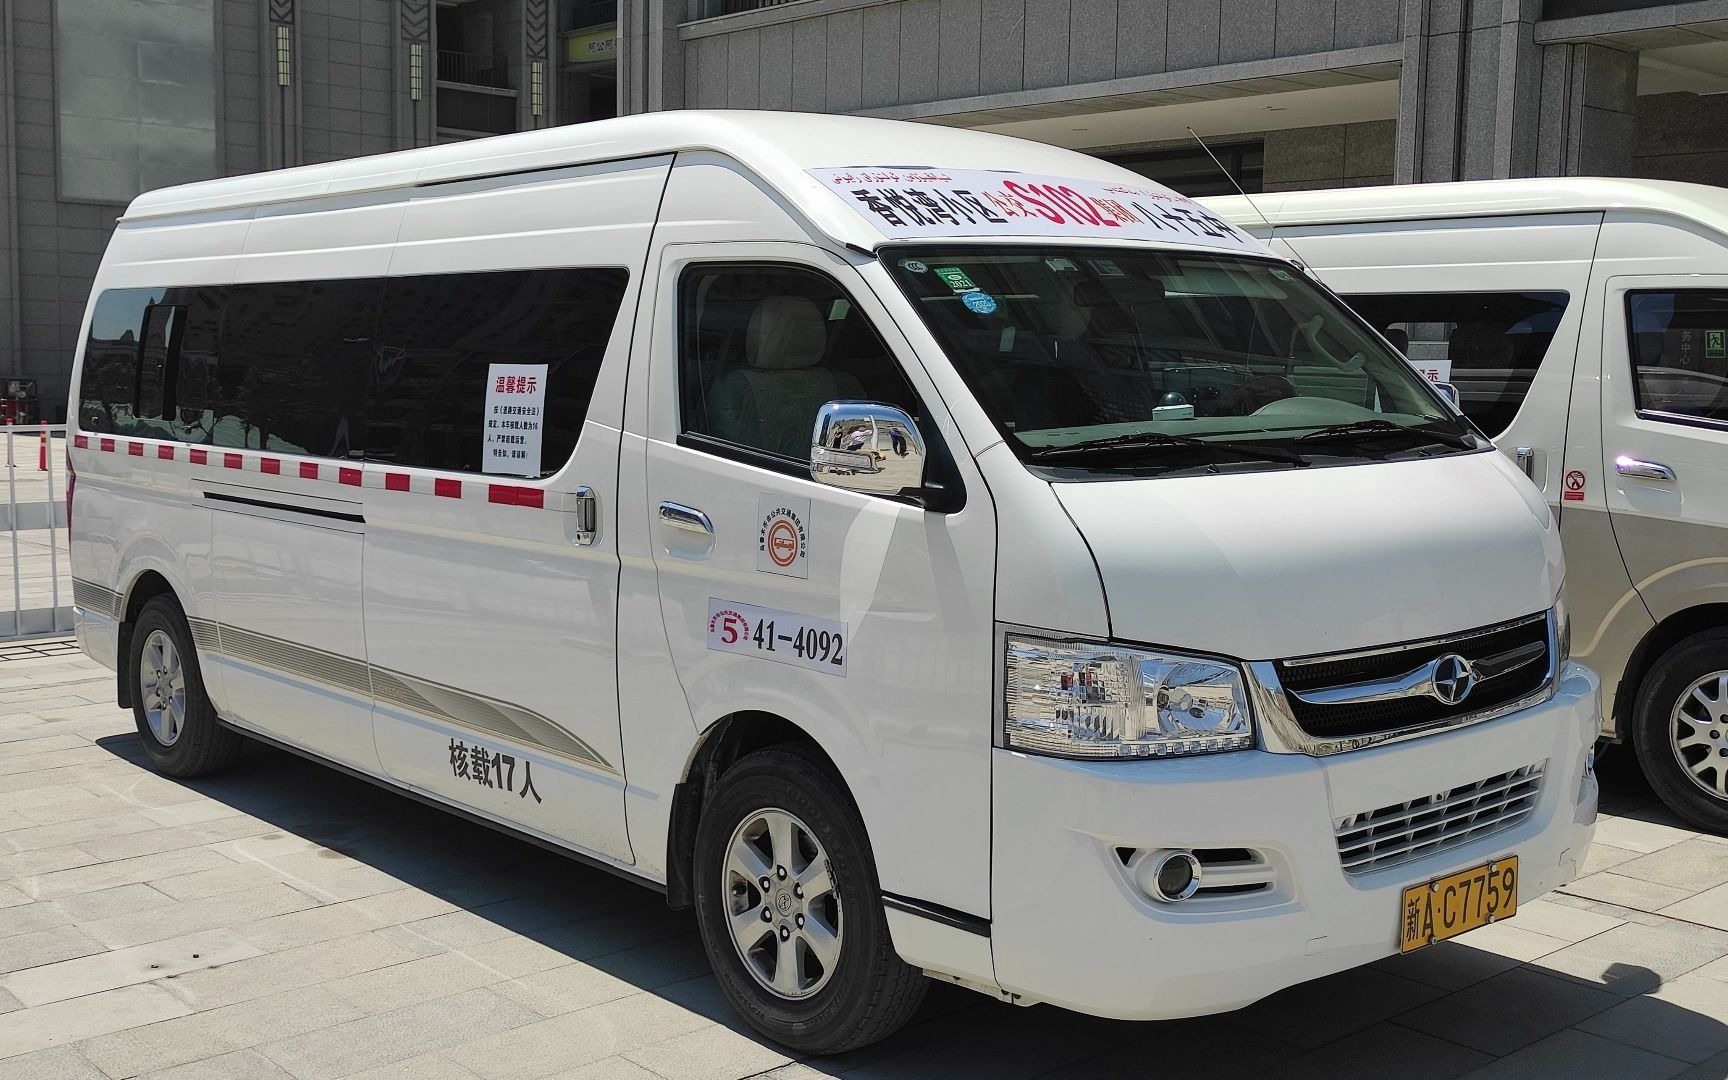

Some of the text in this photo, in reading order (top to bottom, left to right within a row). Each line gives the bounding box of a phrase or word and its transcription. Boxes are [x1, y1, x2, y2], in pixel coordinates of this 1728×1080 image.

[851, 188, 1008, 227] 香悦湾小区
[982, 190, 1037, 218] 公交
[1003, 180, 1121, 228] S102
[1131, 200, 1244, 243] 八十五中
[949, 279, 974, 288] 2021
[495, 375, 537, 395] 温馨提示
[721, 617, 738, 644] 5
[752, 618, 843, 666] 41-4092
[448, 737, 543, 805] 核载17人
